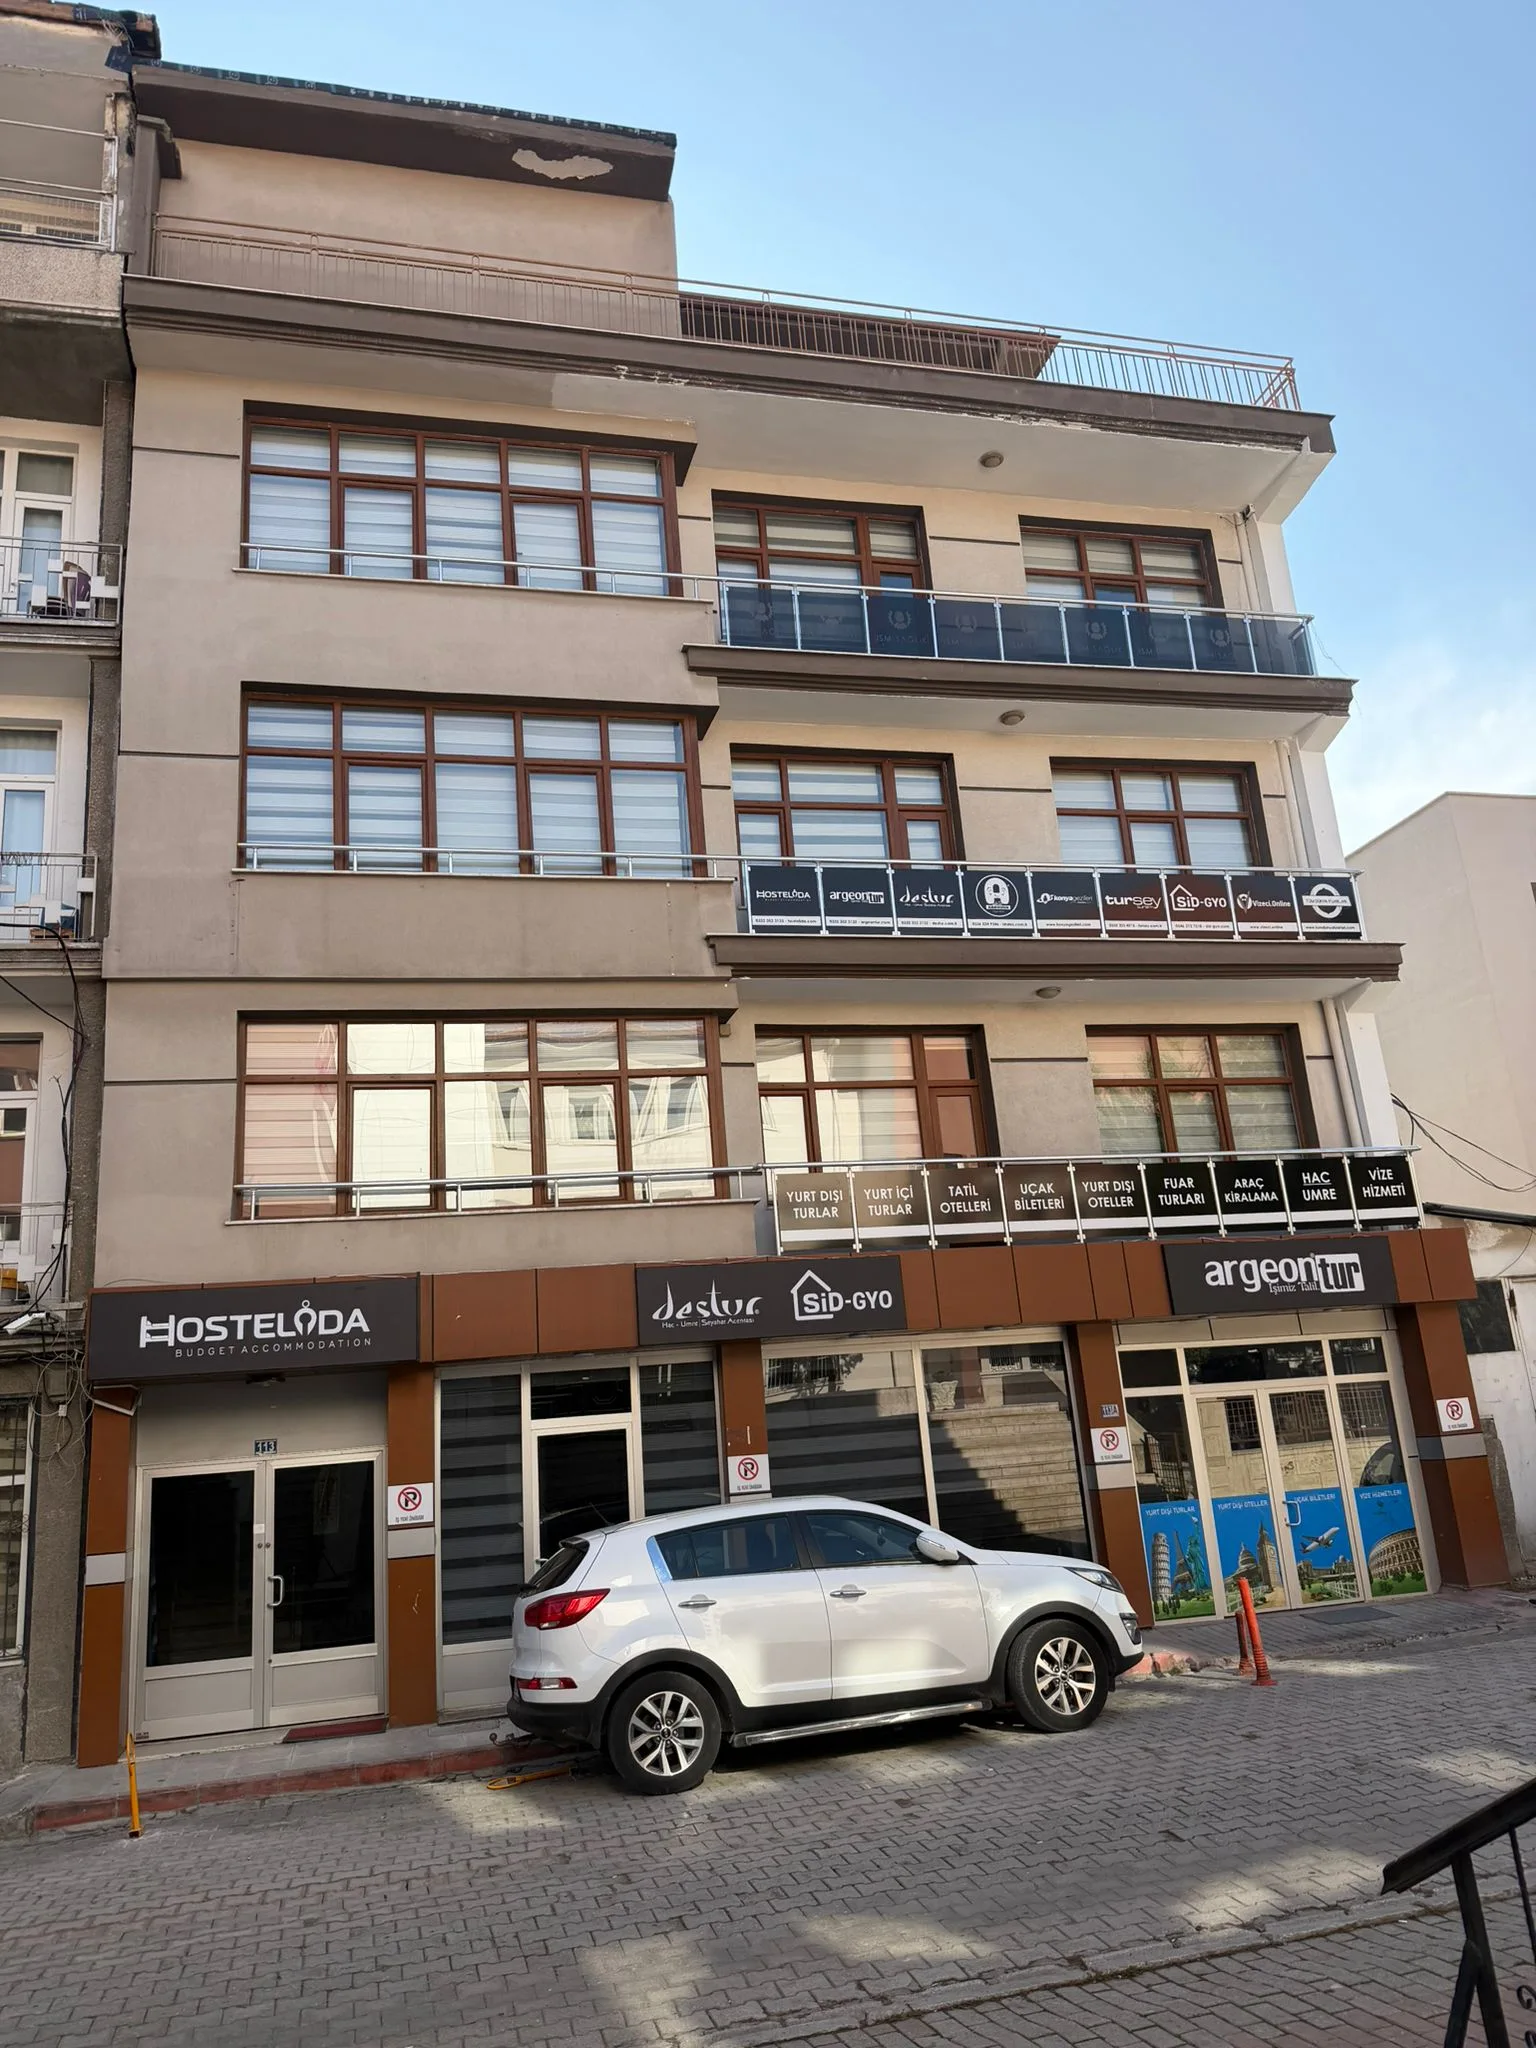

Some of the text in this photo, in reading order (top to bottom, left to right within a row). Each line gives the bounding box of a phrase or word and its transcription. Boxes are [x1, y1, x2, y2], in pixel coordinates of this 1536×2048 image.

[1105, 895, 1161, 909] tursey
[1302, 1171, 1330, 1184] HAC
[1368, 1166, 1394, 1181] VİZE
[1020, 1182, 1055, 1197] UÇAK
[1082, 1179, 1135, 1194] YURT DIŞI
[1164, 1177, 1194, 1189] FUAR
[1234, 1177, 1264, 1191] ARAÇ
[1362, 1182, 1406, 1198] HİZMETİ
[786, 1189, 843, 1203] YURT DIŞI
[864, 1184, 914, 1201] YURT İÇİ
[948, 1184, 979, 1198] TATİL
[1224, 1187, 1279, 1203] KİRALAMA
[1302, 1187, 1337, 1201] UMRE
[1014, 1195, 1065, 1211] BİLETLERİ
[1088, 1195, 1134, 1209] OTELLER
[1158, 1192, 1205, 1206] TURLARI
[793, 1206, 839, 1220] TURLAR
[868, 1203, 912, 1217] TURLAR
[940, 1199, 992, 1214] OTELLERİ
[652, 1279, 763, 1320] destur
[175, 1338, 372, 1358] BUDGET ACCOMMODATION
